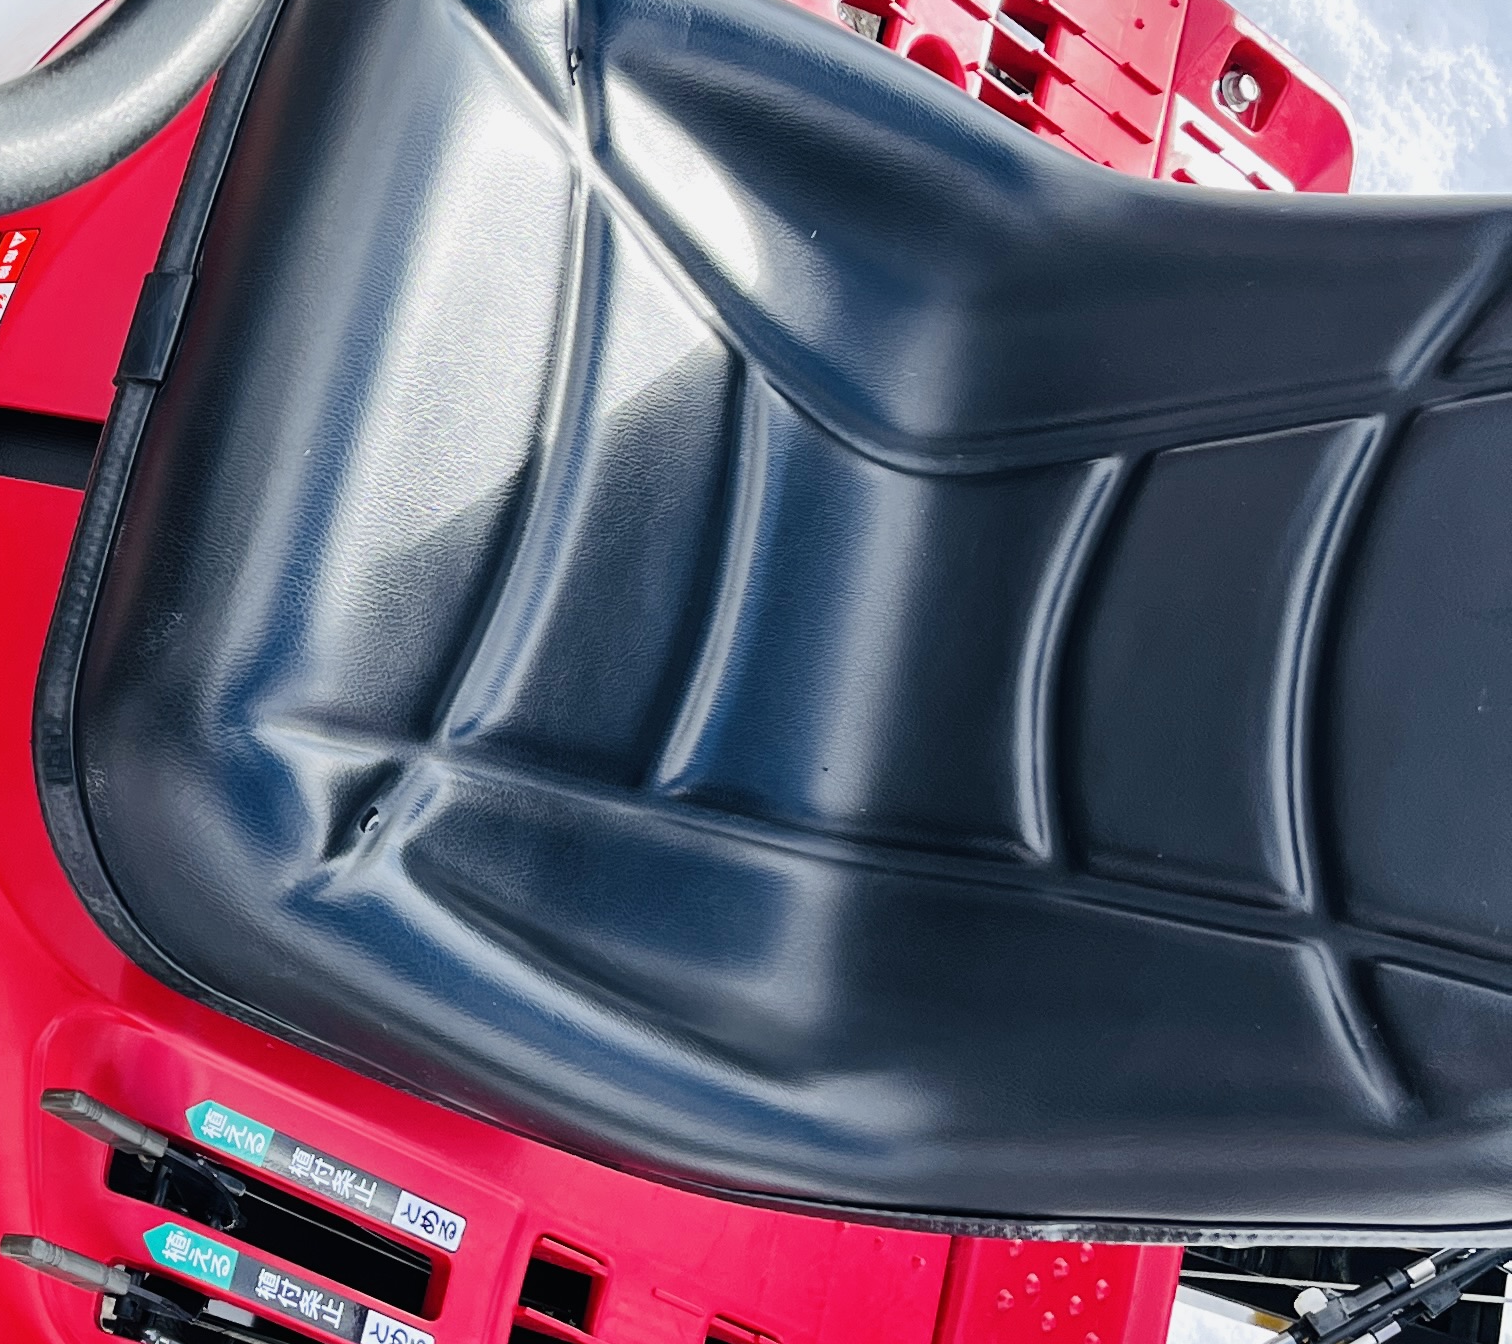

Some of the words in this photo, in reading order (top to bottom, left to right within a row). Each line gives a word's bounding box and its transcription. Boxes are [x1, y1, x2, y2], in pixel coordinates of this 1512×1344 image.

[198, 1106, 269, 1156] 植える
[288, 1146, 379, 1209] 植付条止
[402, 1196, 461, 1243] とめる
[161, 1228, 233, 1278] 植える
[254, 1267, 345, 1330] 植付条止
